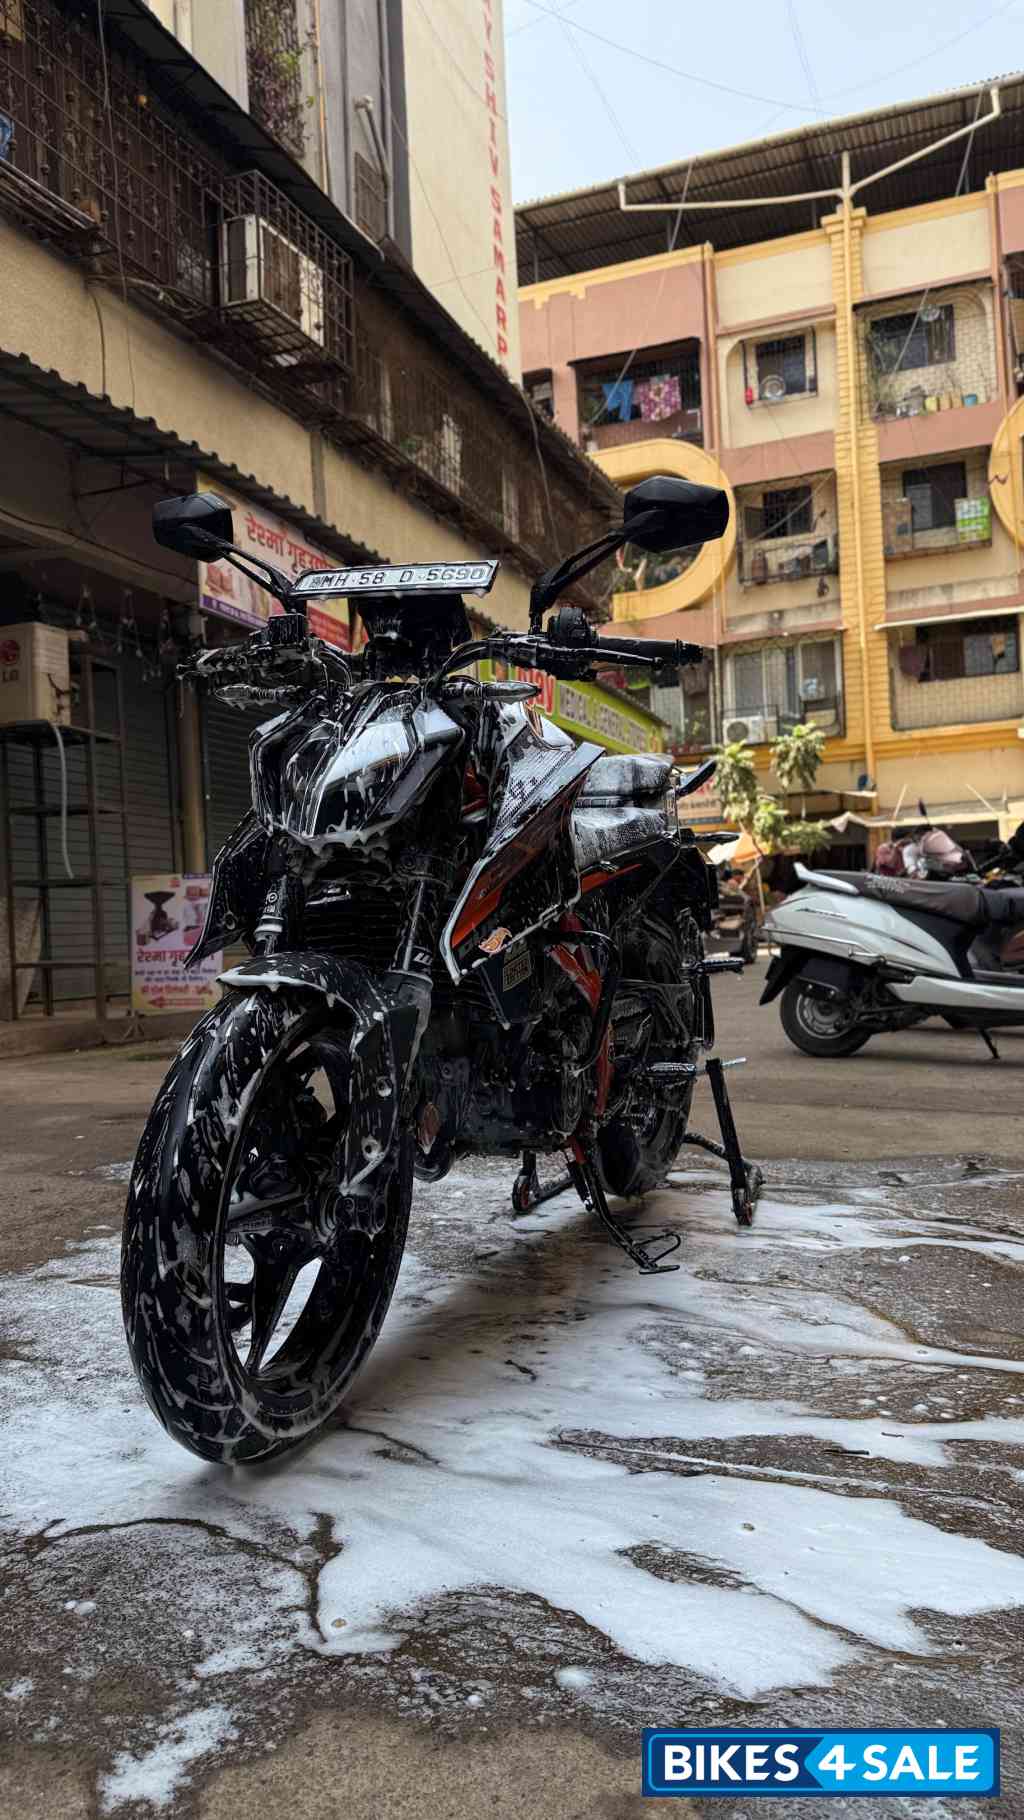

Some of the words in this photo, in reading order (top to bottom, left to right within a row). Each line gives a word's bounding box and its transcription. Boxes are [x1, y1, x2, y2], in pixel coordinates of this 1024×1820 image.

[321, 573, 349, 588] MH
[359, 571, 386, 585] 58
[426, 567, 486, 582] 5690
